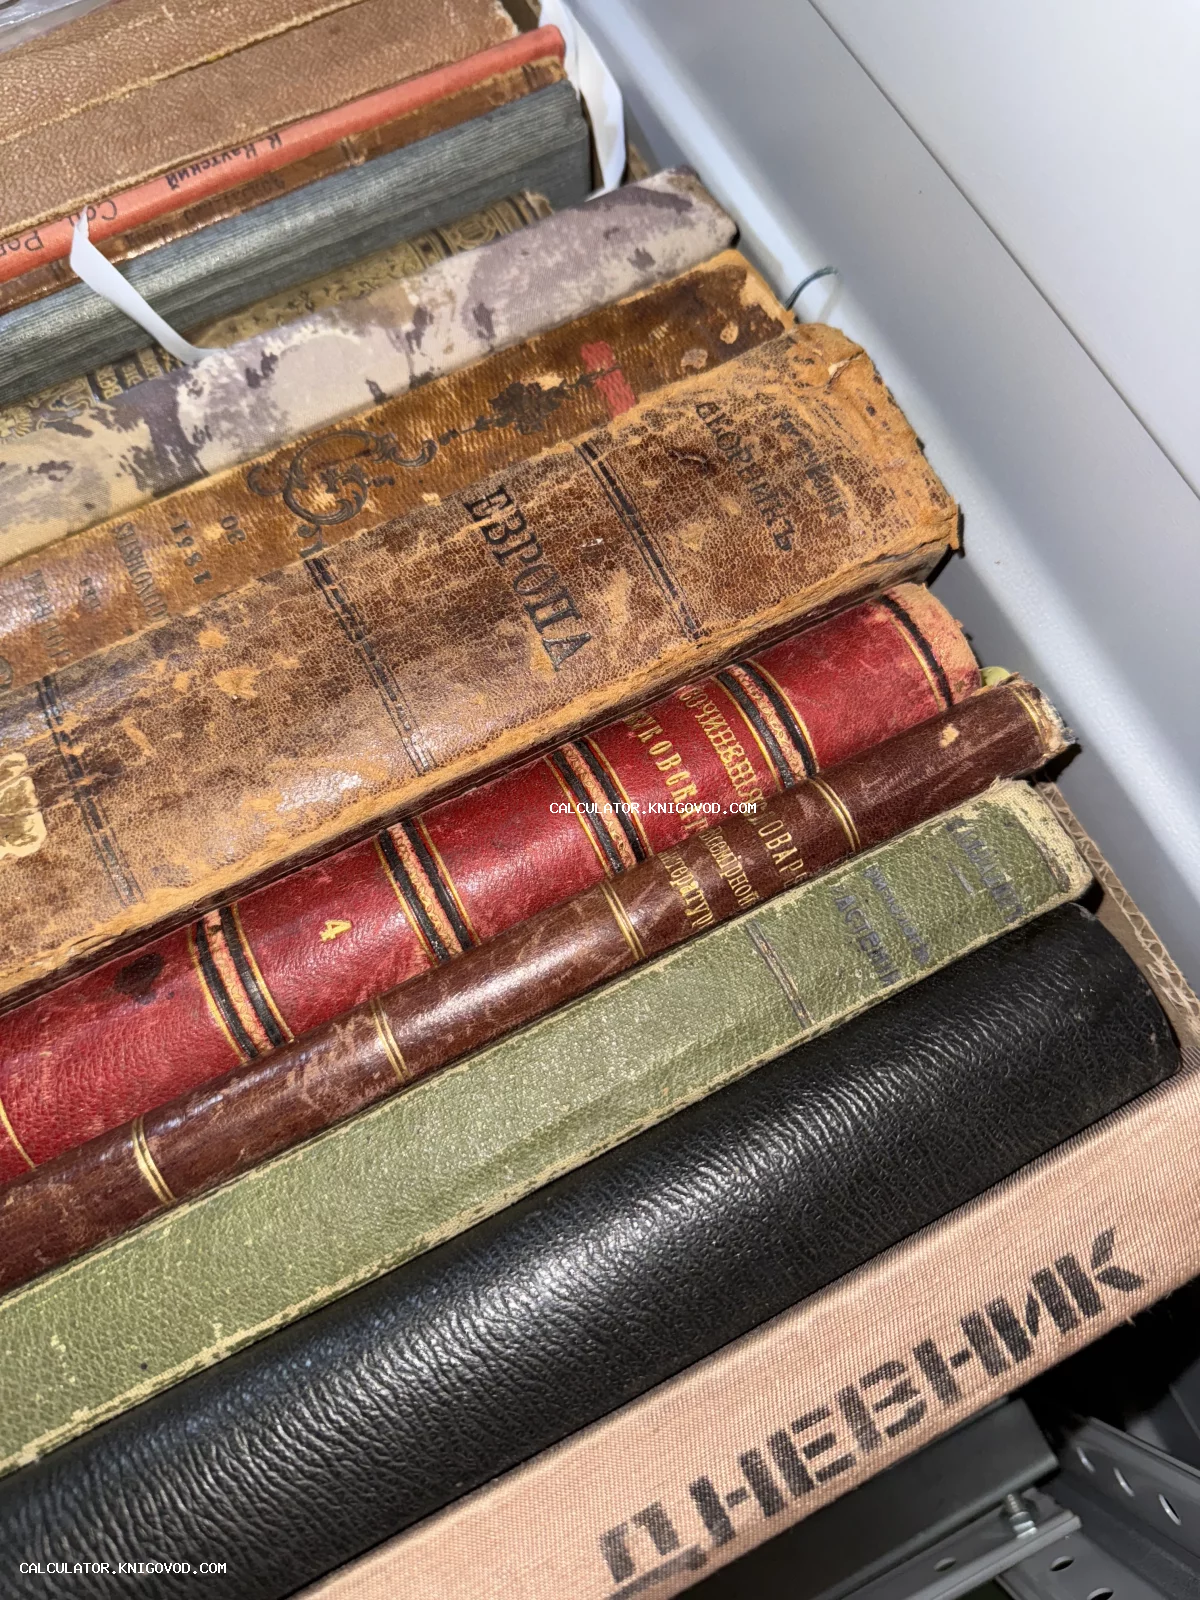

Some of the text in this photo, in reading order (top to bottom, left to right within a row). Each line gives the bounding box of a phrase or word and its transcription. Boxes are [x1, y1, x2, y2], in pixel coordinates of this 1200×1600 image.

[165, 142, 258, 190] Каутский
[112, 520, 172, 624] CONOMISTES
[463, 485, 593, 672] ЕВРОПА
[699, 825, 759, 907] Всемірной
[319, 919, 352, 943] 4
[599, 1226, 1145, 1600] ДНЕВНИК
